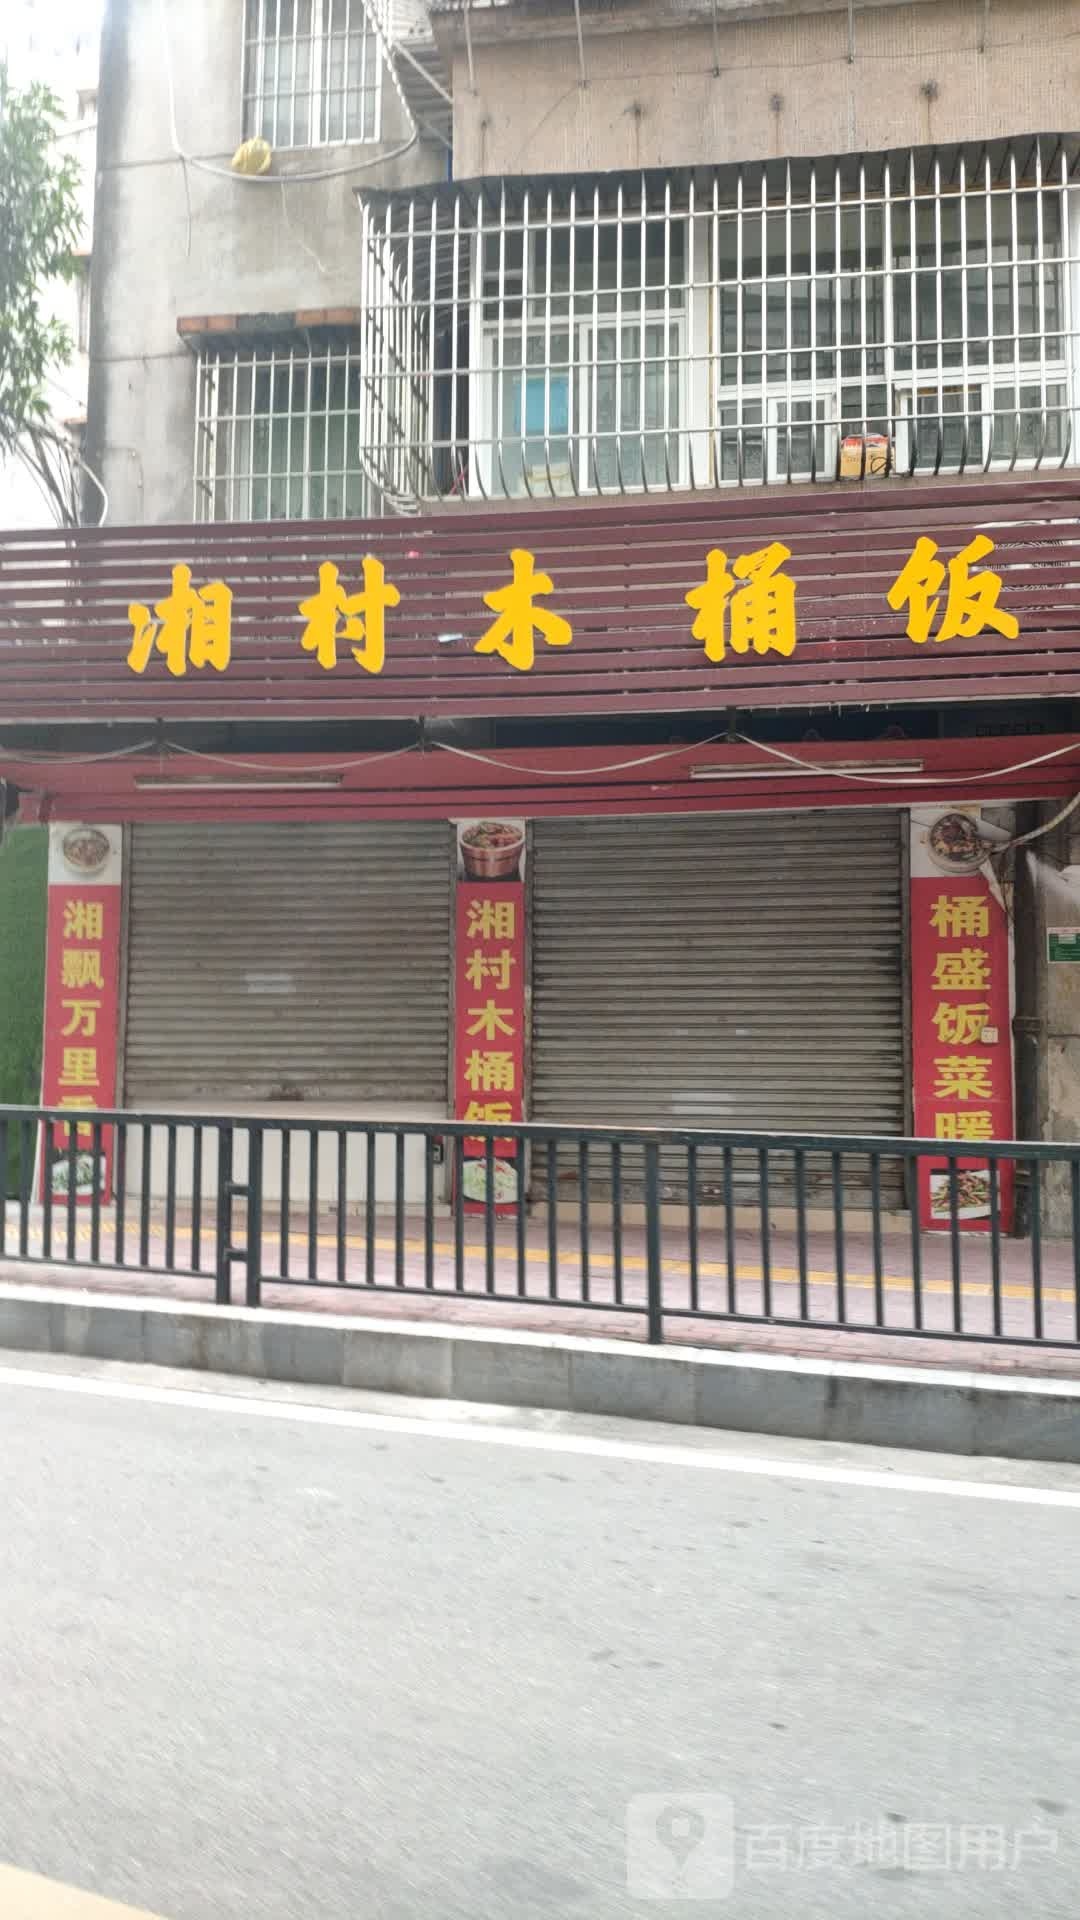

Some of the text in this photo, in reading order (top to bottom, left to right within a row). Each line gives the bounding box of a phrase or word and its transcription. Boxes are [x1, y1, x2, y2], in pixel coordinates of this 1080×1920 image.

[128, 533, 1021, 674] 湘村木桶饭
